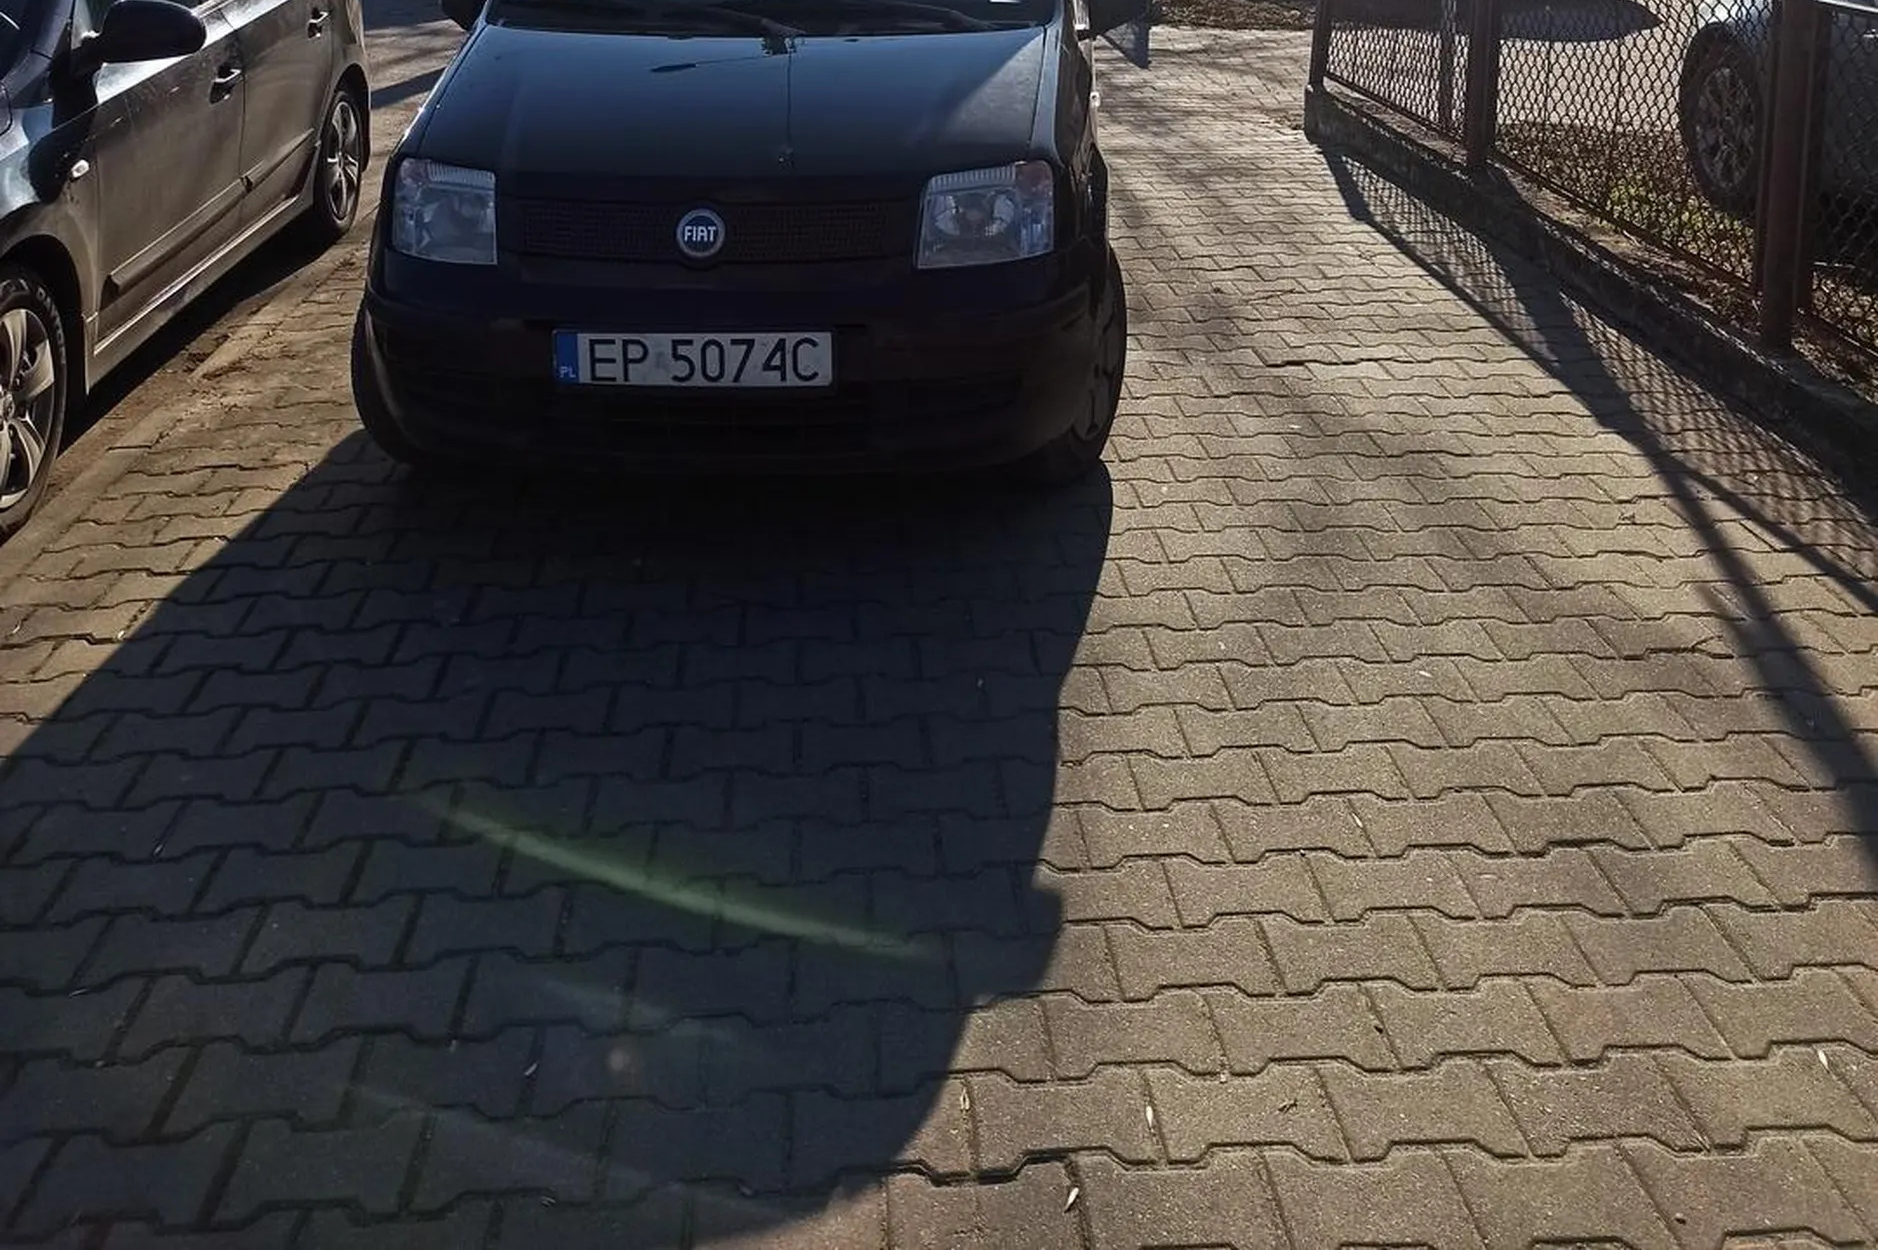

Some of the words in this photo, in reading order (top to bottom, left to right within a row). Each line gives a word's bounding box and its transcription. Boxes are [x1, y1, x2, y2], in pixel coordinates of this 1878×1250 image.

[684, 226, 716, 241] FIAT
[588, 338, 649, 382] EP
[671, 338, 819, 382] 5074C
[560, 366, 576, 378] PL
